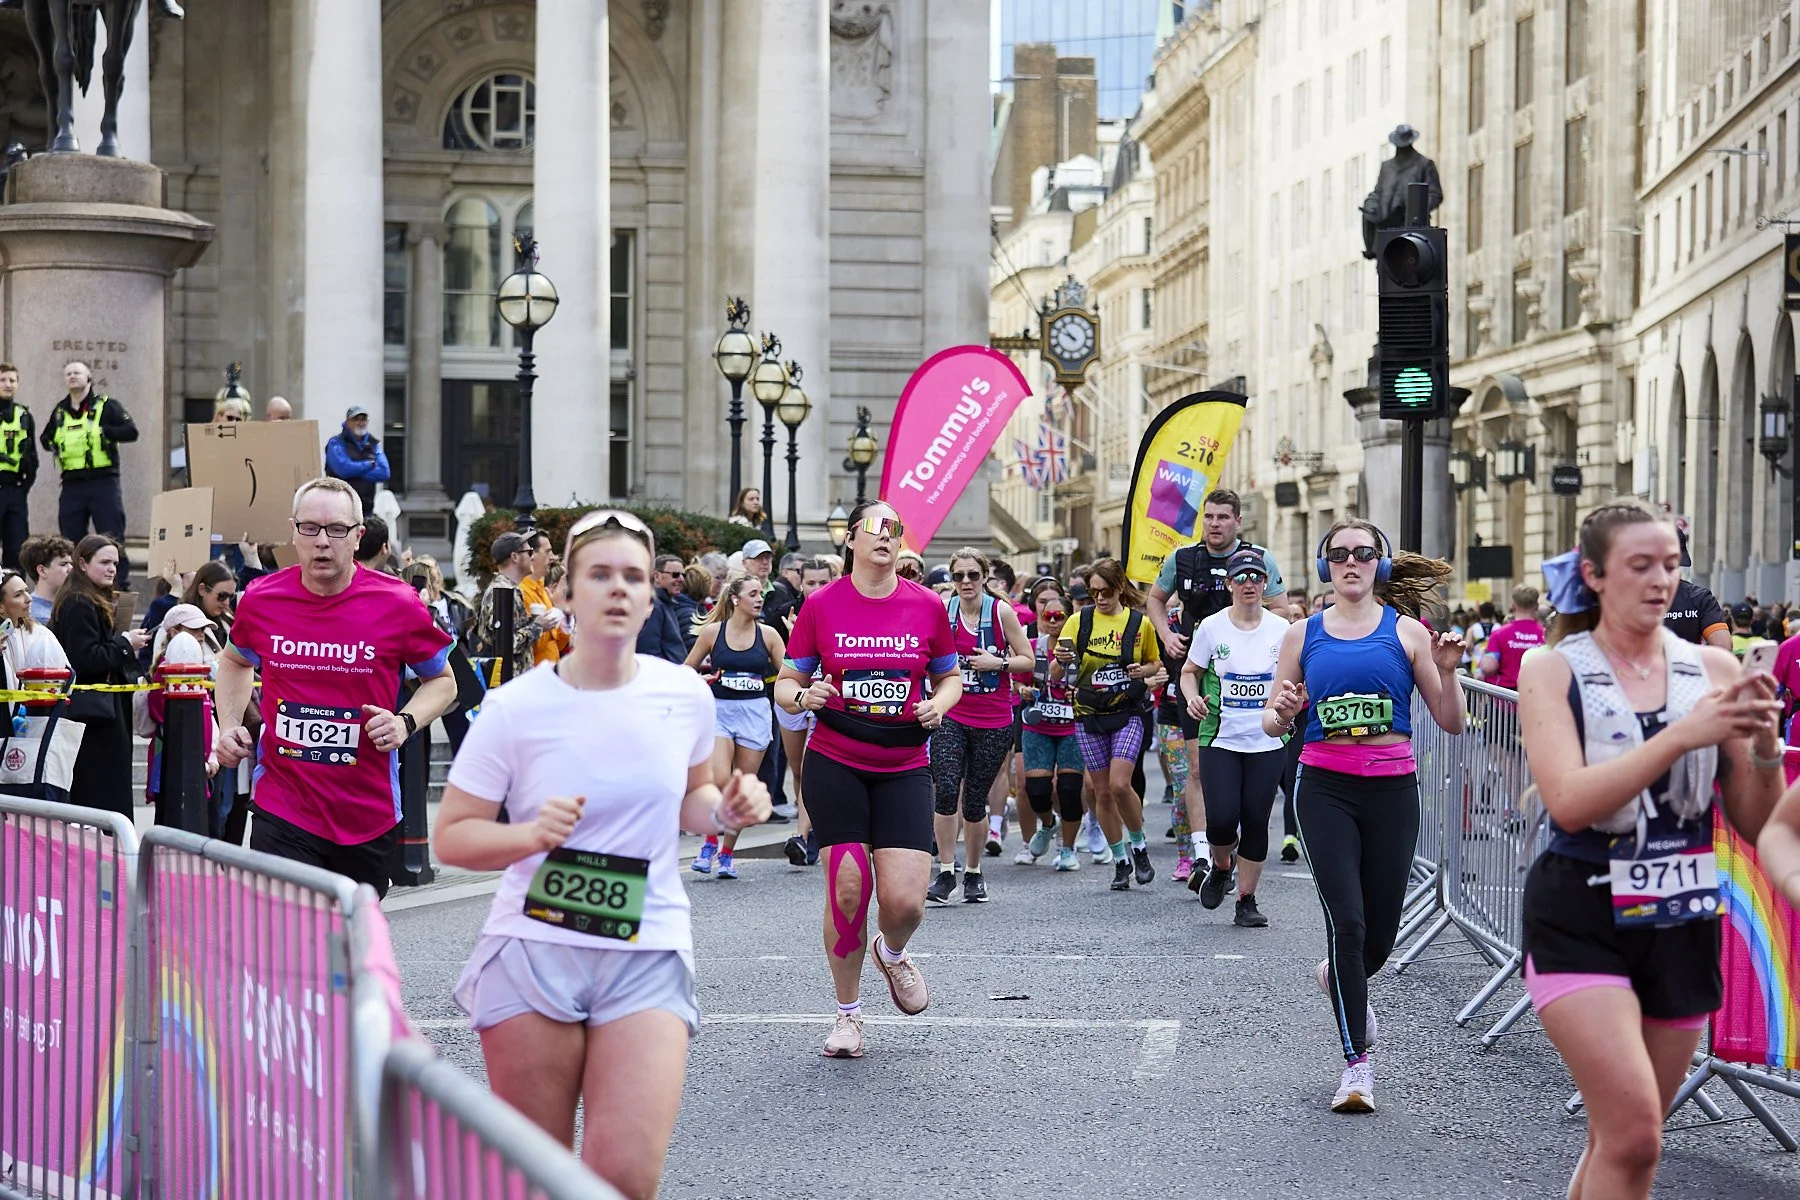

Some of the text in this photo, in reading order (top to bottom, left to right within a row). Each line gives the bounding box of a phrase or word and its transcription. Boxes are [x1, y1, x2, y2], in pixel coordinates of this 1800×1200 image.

[52, 341, 128, 352] ERECTED
[63, 359, 102, 370] JNE
[898, 376, 991, 493] Tommy's
[938, 452, 967, 492] pregnancy
[963, 435, 976, 453] and
[973, 416, 992, 438] baby
[986, 391, 1008, 418] charity
[1199, 436, 1220, 451] SUB
[1159, 468, 1199, 491] WAVE
[1685, 610, 1698, 618] UK
[834, 633, 919, 651] Tommy's
[1088, 636, 1107, 647] NDON
[1514, 631, 1538, 641] Team
[270, 635, 376, 664] Tommy's
[279, 662, 316, 671] pregnancy
[331, 665, 349, 673] baby
[350, 666, 374, 674] charity
[725, 680, 761, 690] 11403
[848, 682, 907, 699] 10669
[1230, 683, 1265, 697] 3060
[300, 707, 335, 717] SPENCER
[1040, 704, 1067, 716] 9331
[1323, 701, 1385, 725] 23761
[282, 719, 351, 745] 11621
[1647, 839, 1687, 850] MEGHAN
[576, 855, 608, 868] MILLS
[1629, 859, 1699, 890] 9711
[544, 870, 629, 910] 6288
